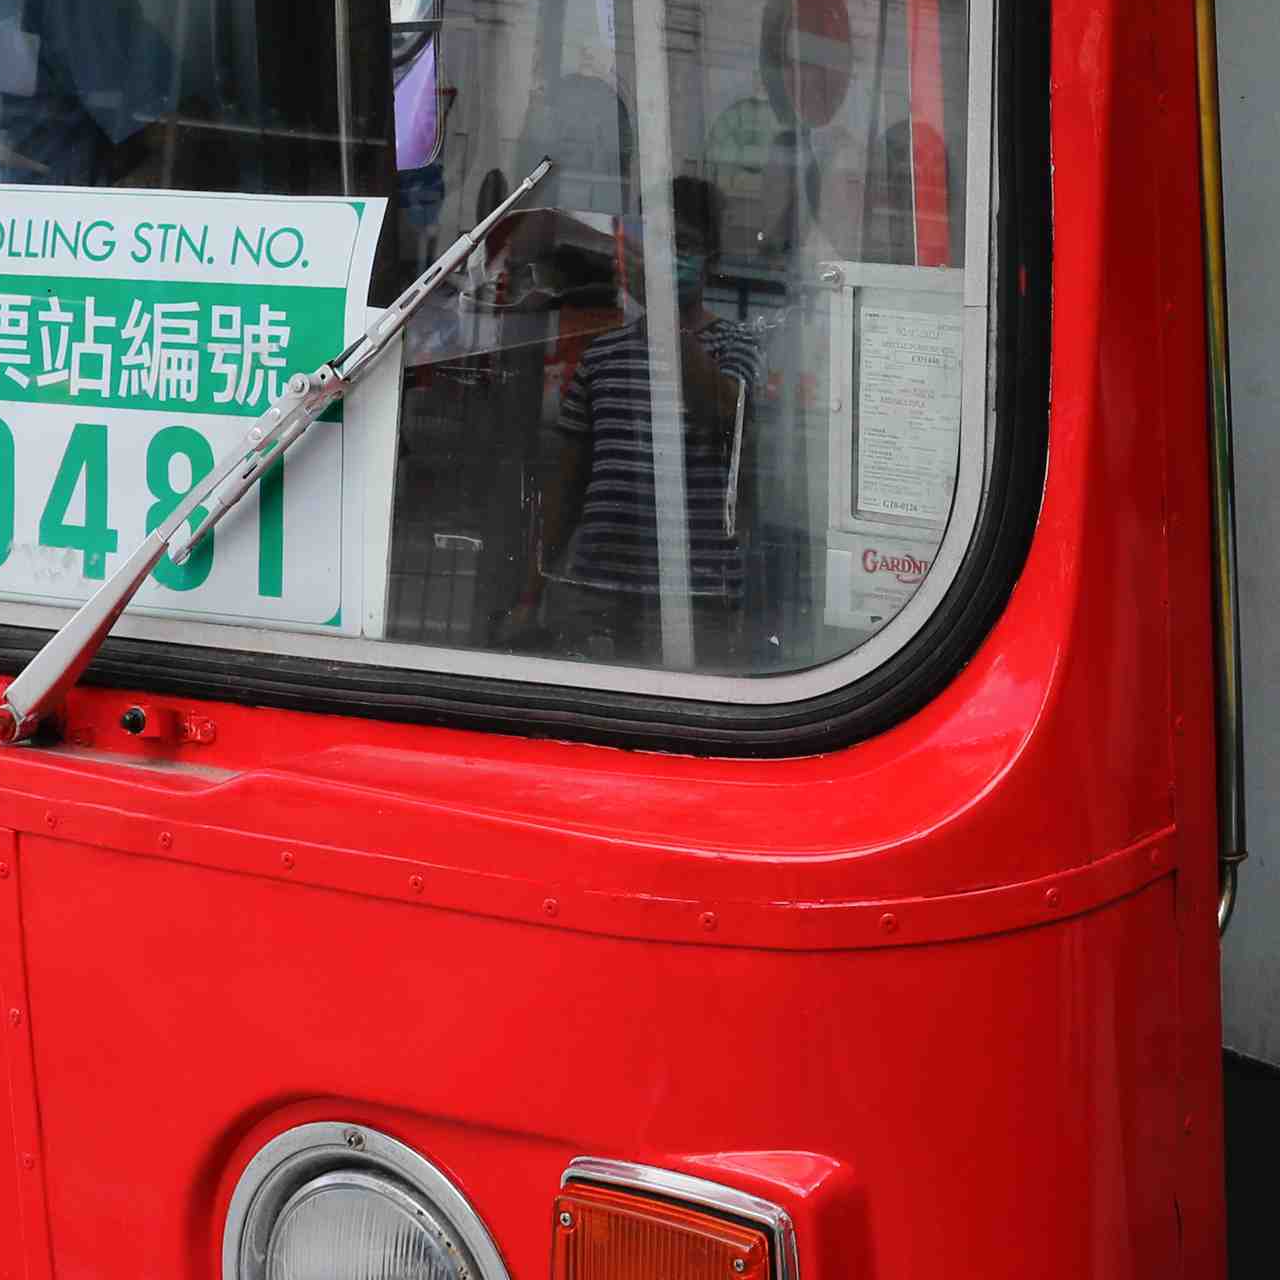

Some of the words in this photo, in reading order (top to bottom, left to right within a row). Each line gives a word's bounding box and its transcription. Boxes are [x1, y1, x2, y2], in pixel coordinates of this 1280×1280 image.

[130, 222, 215, 265] STN.
[230, 226, 310, 269] NO.
[862, 548, 929, 584] GARDN
